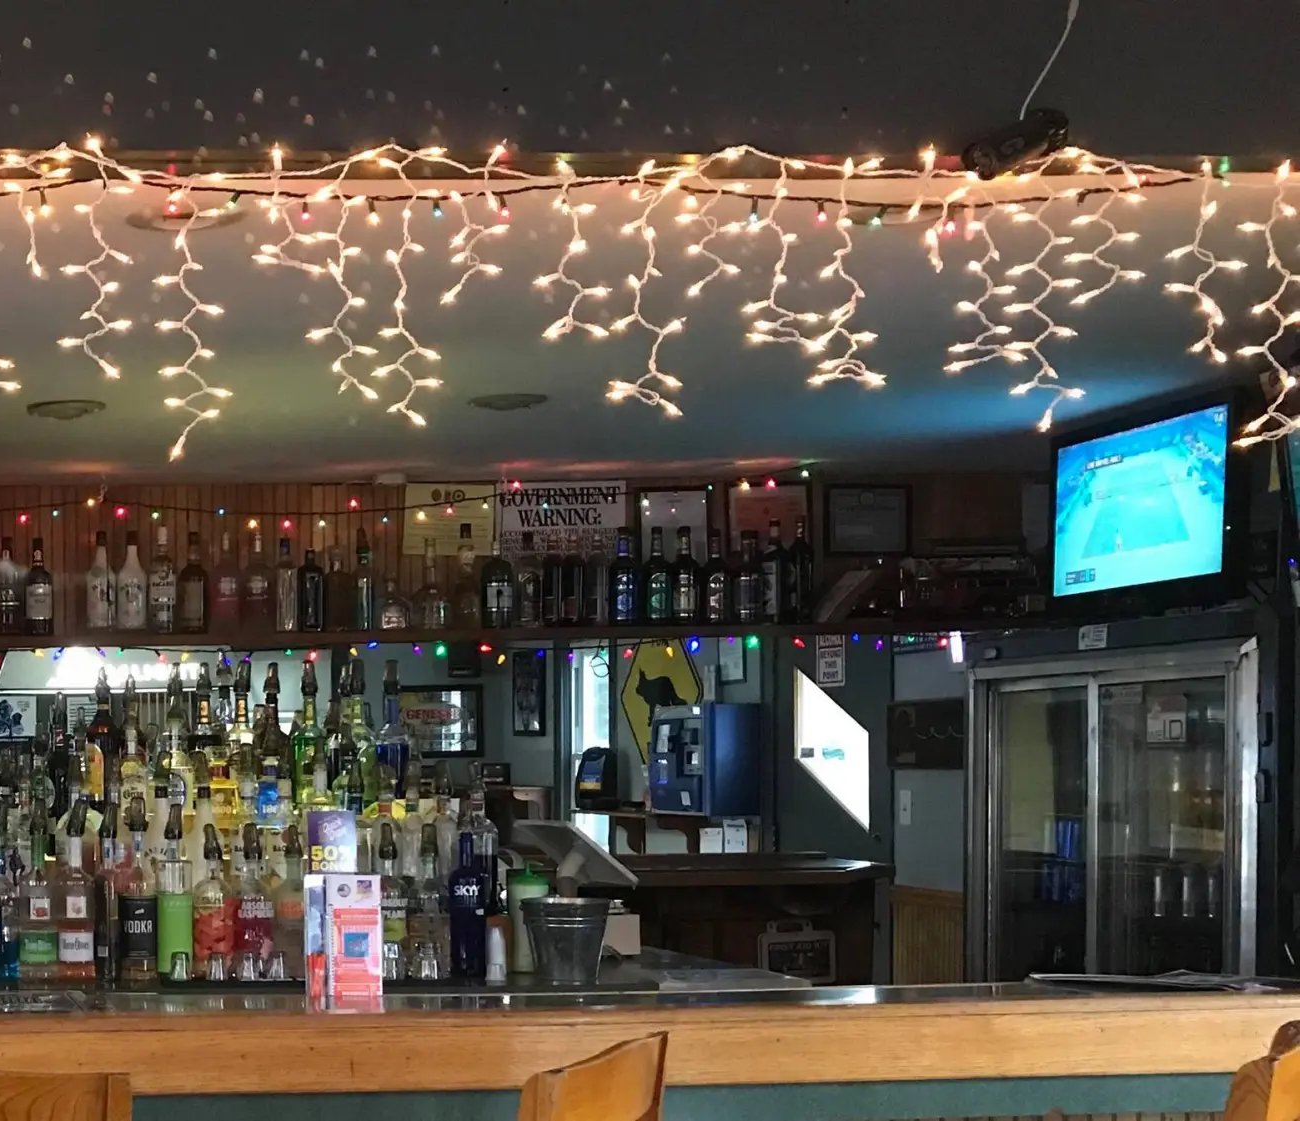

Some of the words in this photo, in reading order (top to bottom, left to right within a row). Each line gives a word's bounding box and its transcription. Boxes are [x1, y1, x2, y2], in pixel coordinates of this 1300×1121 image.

[500, 486, 620, 508] GOVERNMENT
[518, 507, 602, 527] WARNING:
[822, 670, 839, 680] POINT
[123, 919, 153, 934] VODKA
